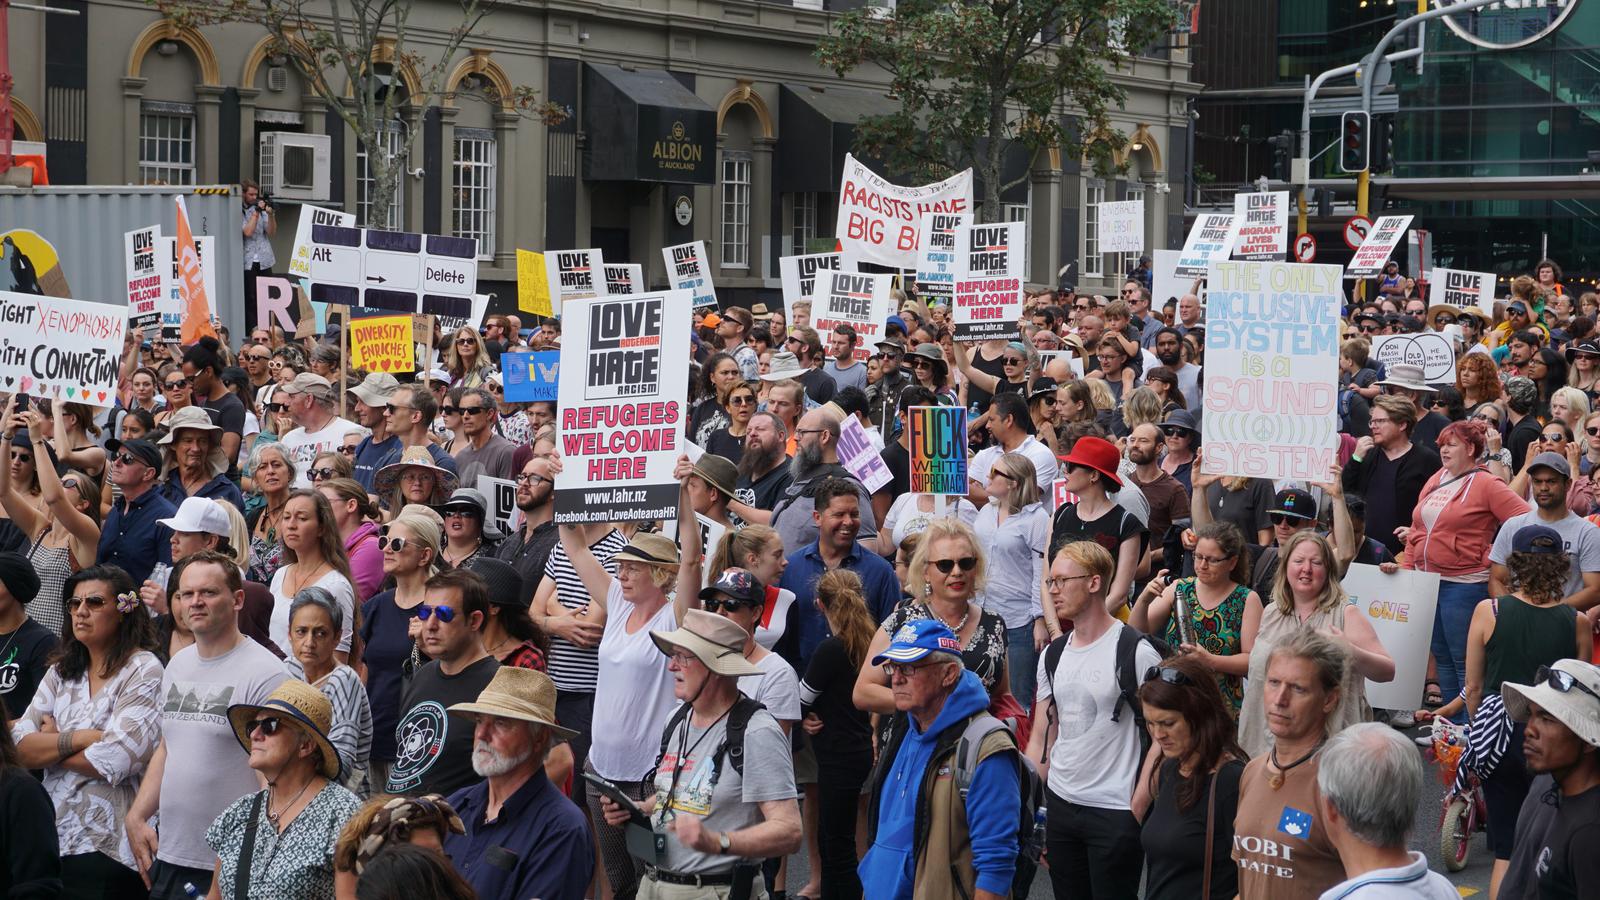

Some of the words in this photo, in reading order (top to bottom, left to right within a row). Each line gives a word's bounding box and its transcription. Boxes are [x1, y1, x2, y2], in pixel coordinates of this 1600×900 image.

[652, 141, 702, 161] ALBION
[665, 161, 695, 170] AUCKLAND
[842, 180, 913, 221] RACISTS
[1247, 194, 1277, 210] LOVE
[847, 212, 885, 244] BIG
[1204, 216, 1234, 228] LOVE
[1238, 226, 1282, 236] MIGRANT
[1379, 218, 1403, 230] LOVE
[133, 230, 153, 254] LOVE
[970, 227, 1008, 252] LOVE
[1241, 244, 1278, 253] MATTER
[1247, 235, 1273, 244] LIVES
[312, 247, 332, 262] Alt
[557, 253, 590, 271] LOVE
[672, 246, 696, 263] LOVE
[426, 267, 465, 284] Delete
[604, 267, 630, 282] LOVE
[798, 256, 840, 279] LOVE
[129, 275, 161, 290] REFUGEES
[831, 274, 874, 296] LOVE
[956, 279, 1020, 294] REFUGEES
[1216, 263, 1261, 291] THE
[1270, 265, 1343, 294] ONLY
[1445, 272, 1481, 290] LOVE
[129, 287, 161, 303] WELCOME
[956, 292, 1019, 307] WELCOME
[137, 301, 155, 313] HERE
[971, 307, 1003, 320] HERE
[1207, 292, 1336, 325] INCLUSIVE
[36, 301, 121, 339] XENOPHOBIA
[590, 300, 661, 350] LOVE
[355, 323, 406, 344] DIVERSITY
[1207, 320, 1338, 356] SYSTEM
[360, 342, 407, 362] ENRICHES
[1241, 351, 1266, 377] is
[1271, 355, 1291, 377] a
[617, 383, 657, 395] RACISM
[1205, 376, 1336, 416] SOUND
[562, 401, 679, 431] REFUGEES
[562, 428, 676, 457] WELCOME
[911, 408, 967, 459] FUCK
[587, 456, 647, 482] HERE
[912, 460, 966, 473] WHITE
[1204, 442, 1333, 481] SYSTEM
[912, 473, 966, 492] SUPREMACY
[585, 489, 647, 505] www.lahr.nz
[554, 507, 676, 523] facebook.com/LoveAotearoaHR
[1368, 600, 1409, 622] ONE
[176, 713, 227, 725] ZEALAND
